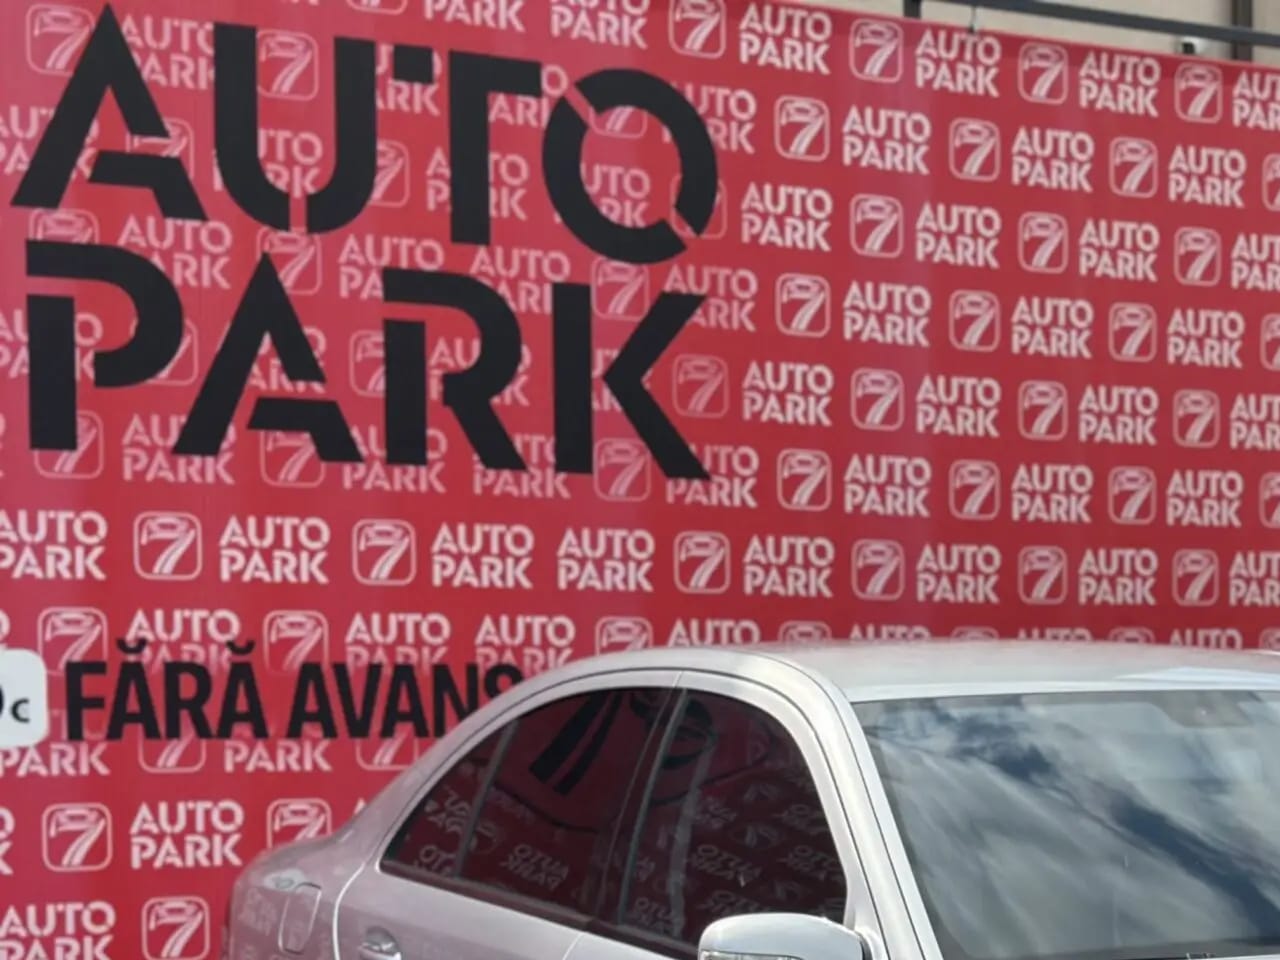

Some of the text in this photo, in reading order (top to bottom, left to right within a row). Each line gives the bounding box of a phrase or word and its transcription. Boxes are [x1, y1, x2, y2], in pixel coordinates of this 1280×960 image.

[551, 6, 648, 49] PARK
[739, 0, 834, 43] AUTO
[740, 30, 830, 75] PARK
[915, 26, 1004, 66] AUTO
[916, 56, 999, 97] PARK
[1079, 48, 1163, 87] AUTO
[1079, 77, 1158, 117] PARK
[12, 5, 718, 264] AUTO
[842, 105, 931, 143] AUTO
[843, 134, 929, 175] PARK
[1012, 127, 1094, 162] AUTO
[1168, 145, 1247, 179] AUTO
[1012, 155, 1092, 192] PARK
[1168, 171, 1244, 208] PARK
[741, 182, 833, 220] AUTO
[117, 214, 233, 253] AUTO
[742, 211, 831, 252] PARK
[916, 202, 1001, 239] AUTO
[1079, 219, 1160, 253] AUTO
[338, 233, 444, 271] AUTO
[469, 247, 571, 282] AUTO
[916, 231, 999, 268] PARK
[1079, 245, 1157, 282] PARK
[664, 264, 758, 300] AUTO
[843, 281, 931, 316] AUTO
[689, 298, 756, 332] ARK
[843, 309, 929, 347] PARK
[1011, 296, 1094, 329] AUTO
[1167, 308, 1245, 339] AUTO
[1012, 324, 1092, 359] PARK
[1167, 335, 1242, 368] PARK
[26, 238, 712, 482] PARK
[743, 361, 834, 395] AUTO
[916, 375, 1001, 408] AUTO
[743, 390, 832, 426] PARK
[1078, 385, 1159, 417] AUTO
[916, 403, 999, 437] PARK
[1079, 412, 1156, 445] PARK
[844, 454, 932, 487] AUTO
[1011, 464, 1093, 494] AUTO
[1166, 470, 1244, 498] AUTO
[844, 482, 929, 517] PARK
[1012, 492, 1091, 523] PARK
[1166, 497, 1241, 527] PARK
[219, 516, 330, 550] AUTO
[431, 523, 534, 556] AUTO
[557, 528, 655, 561] AUTO
[220, 547, 329, 584] PARK
[743, 535, 835, 567] AUTO
[916, 544, 1001, 574] AUTO
[1078, 548, 1158, 576] AUTO
[432, 554, 533, 589] PARK
[558, 557, 653, 592] PARK
[744, 564, 832, 598] PARK
[917, 571, 999, 603] PARK
[1079, 575, 1156, 605] PARK
[125, 608, 241, 643] AUTO
[345, 612, 451, 646] AUTO
[474, 614, 576, 647] AUTO
[666, 619, 760, 648] AUTO
[65, 639, 269, 741] FĂRĂ
[130, 799, 244, 835] AUTO
[131, 833, 242, 869] PARK
[0, 901, 116, 940] AUTO
